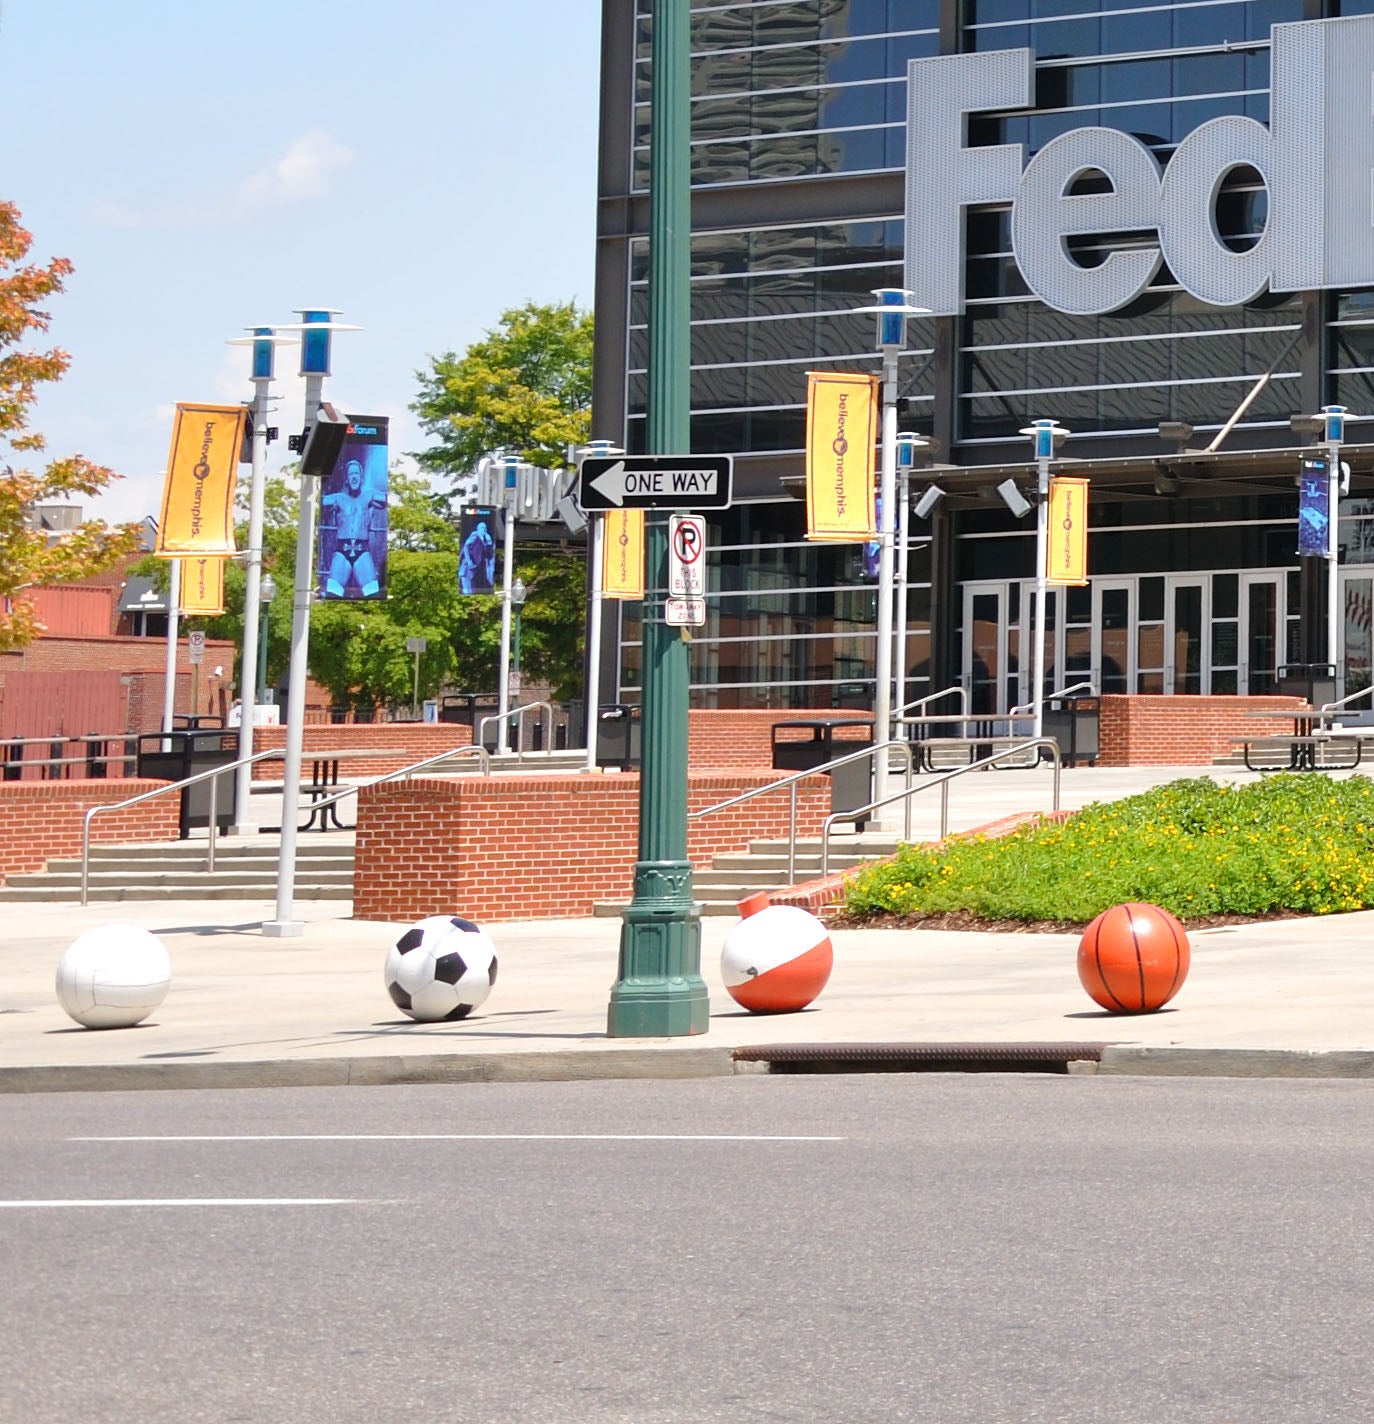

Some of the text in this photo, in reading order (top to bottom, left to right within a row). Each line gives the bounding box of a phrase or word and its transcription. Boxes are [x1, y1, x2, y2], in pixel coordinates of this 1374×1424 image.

[838, 393, 849, 438] believe
[199, 421, 216, 467] believe
[625, 472, 714, 493] ONE WAY
[675, 579, 700, 590] BLOCK
